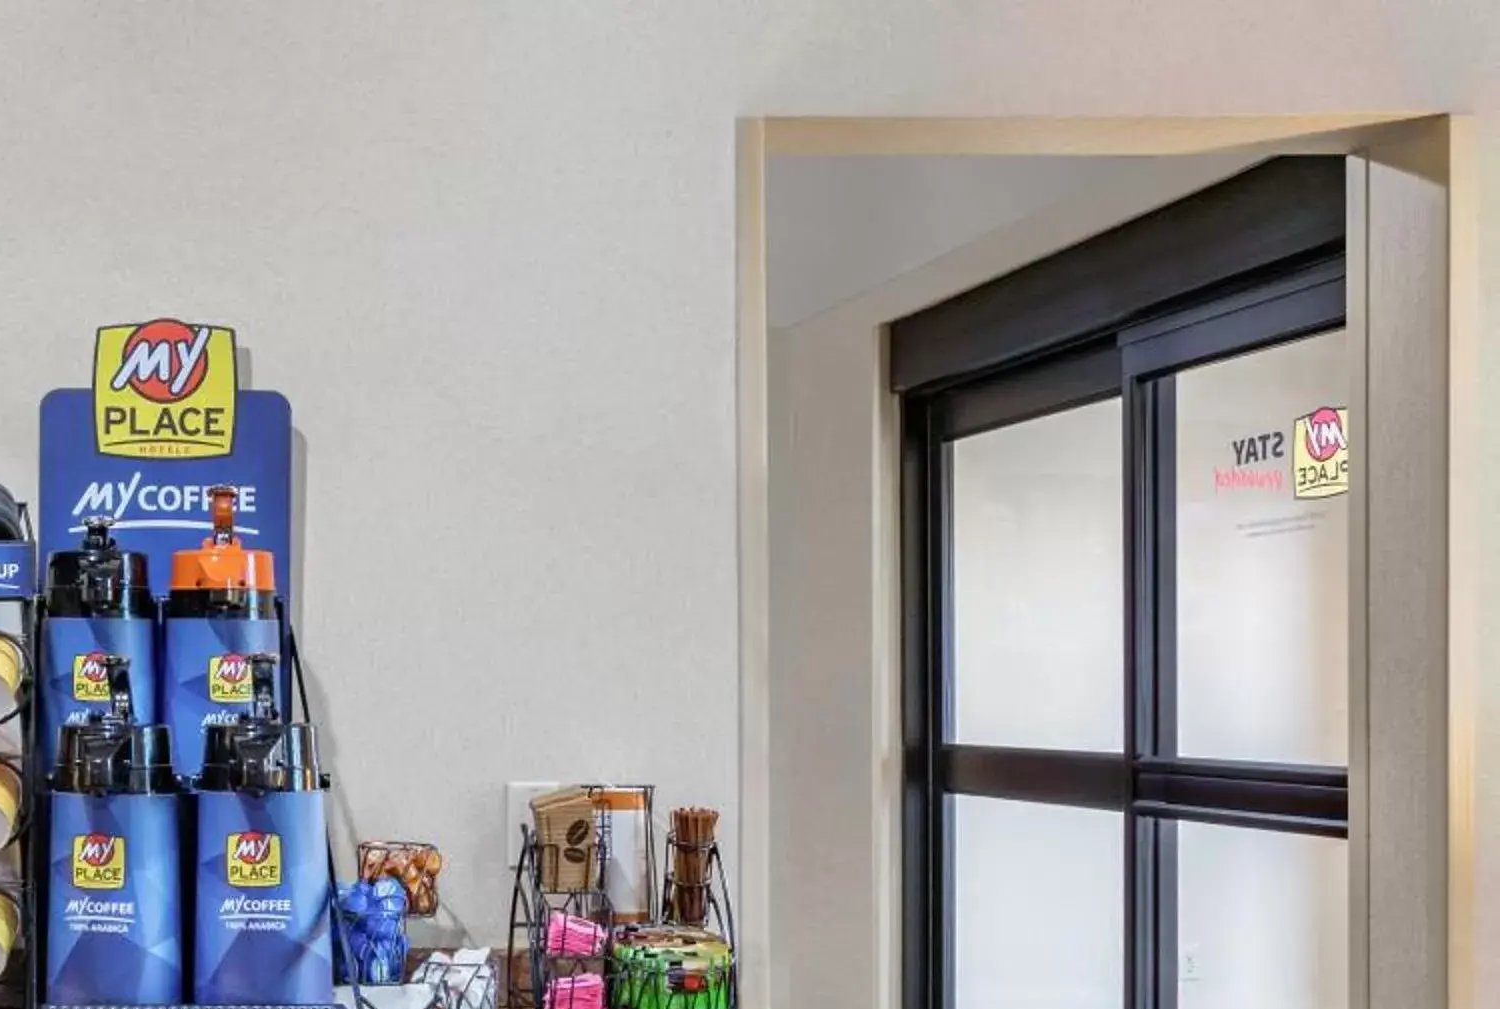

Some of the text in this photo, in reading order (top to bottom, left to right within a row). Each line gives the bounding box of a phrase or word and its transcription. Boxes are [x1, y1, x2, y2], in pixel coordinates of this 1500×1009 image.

[104, 406, 225, 436] PLACE
[76, 867, 122, 881] PLACE
[230, 866, 278, 880] PLACE
